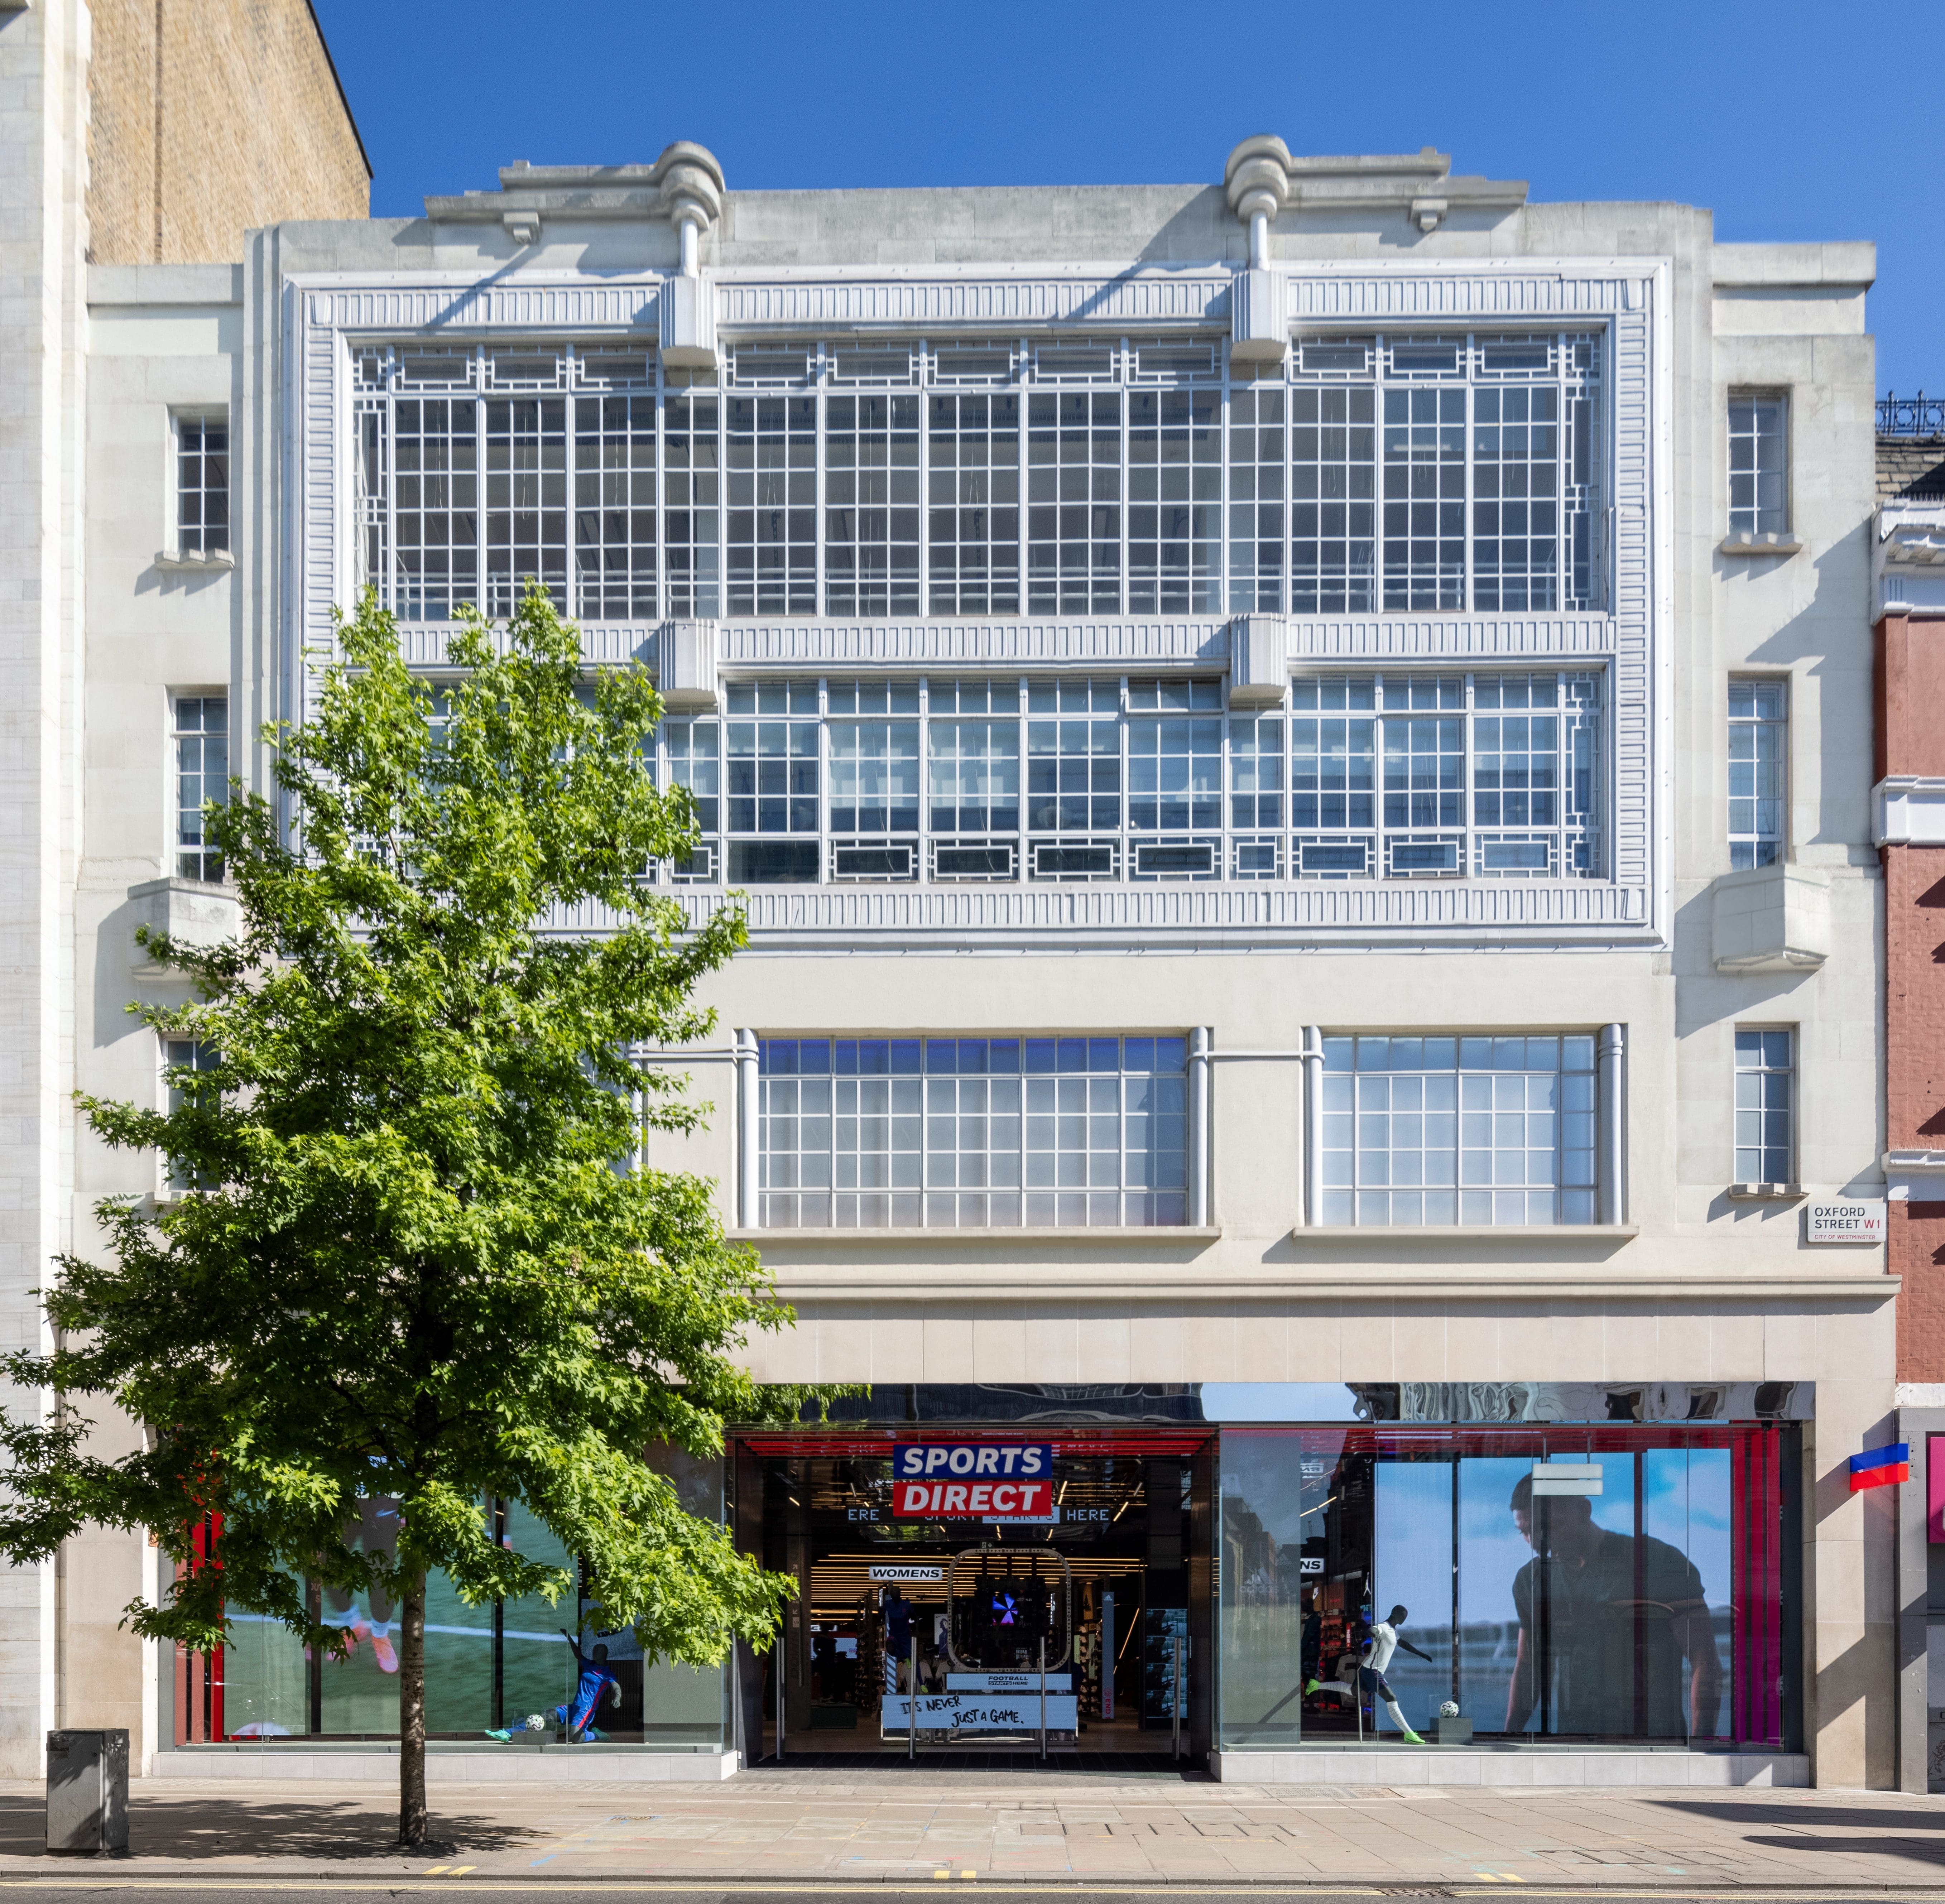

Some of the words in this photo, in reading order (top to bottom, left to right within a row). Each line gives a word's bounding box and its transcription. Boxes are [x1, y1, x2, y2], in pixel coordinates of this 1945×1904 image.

[1815, 1207, 1865, 1217] OXFORD
[1815, 1219, 1860, 1229] STREET
[1864, 1219, 1880, 1229] W1
[903, 1447, 1042, 1474] SPORTS
[903, 1485, 1041, 1511] DIRECT
[848, 1509, 879, 1521] ERE
[1067, 1509, 1110, 1521] HERE
[873, 1569, 940, 1578] WOMENS
[926, 1696, 962, 1711] NEVER
[951, 1709, 980, 1728] JUST
[981, 1712, 986, 1721] A
[990, 1709, 1024, 1724] GAME.
